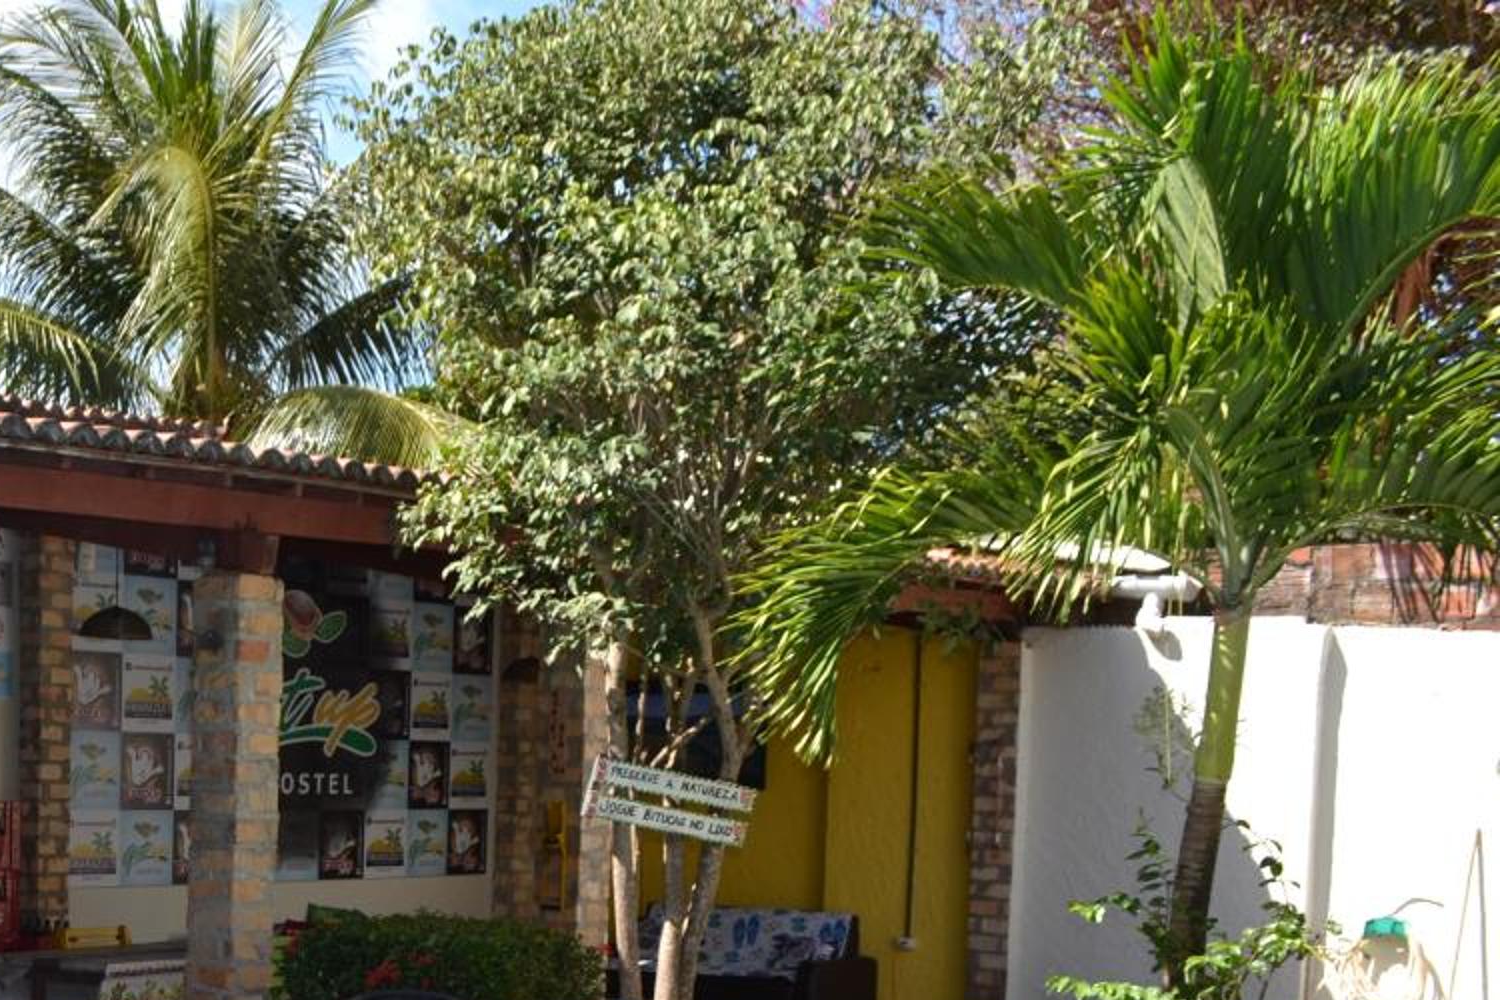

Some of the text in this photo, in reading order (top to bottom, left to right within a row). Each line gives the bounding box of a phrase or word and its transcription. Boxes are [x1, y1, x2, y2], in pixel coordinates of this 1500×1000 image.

[280, 771, 354, 796] OSTEL
[611, 765, 739, 802] PRESERVE A NATUREZA
[598, 799, 733, 838] JOGUE BITUCAS NO LIXO
